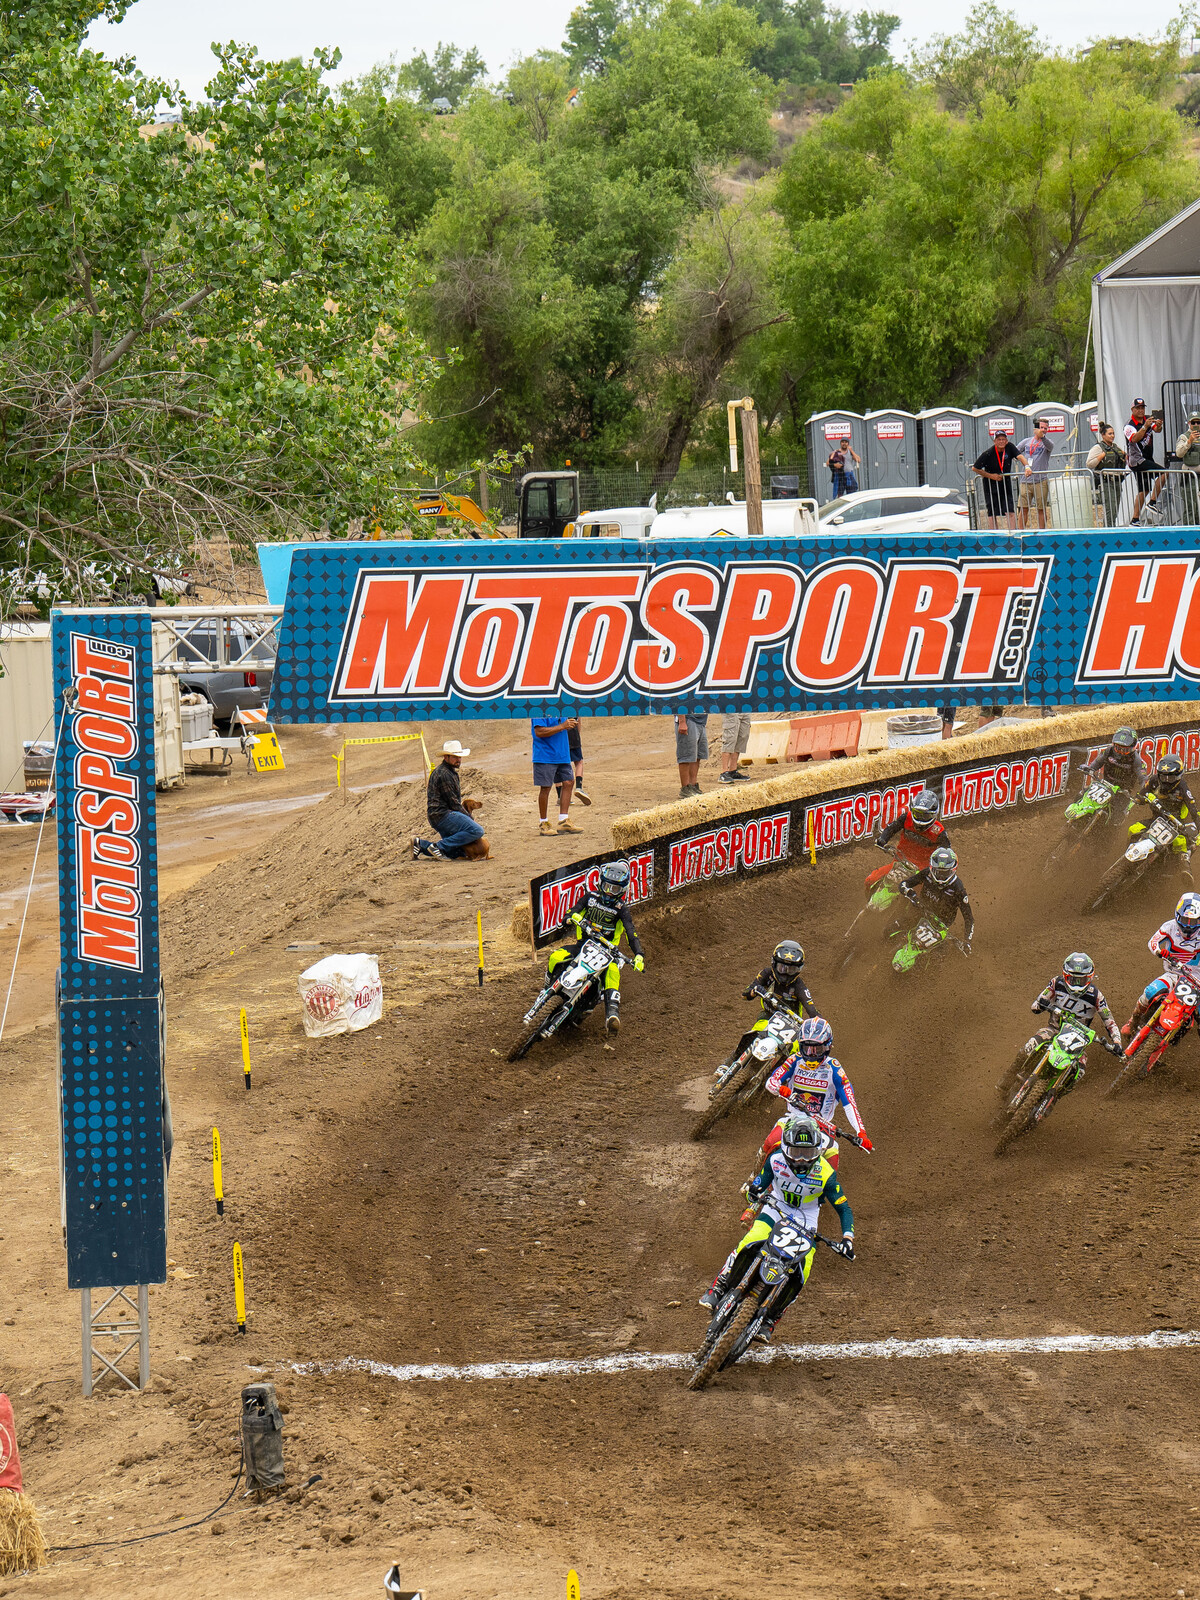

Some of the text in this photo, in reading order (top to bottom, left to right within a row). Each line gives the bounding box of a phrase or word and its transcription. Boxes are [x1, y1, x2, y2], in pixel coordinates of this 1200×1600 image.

[257, 755, 279, 768] EXIT
[1087, 783, 1112, 805] 243
[1149, 823, 1172, 845] 50
[583, 945, 610, 970] 38
[1055, 994, 1092, 1015] FOX
[1175, 984, 1198, 1006] 96
[767, 1018, 796, 1045] 24
[1057, 1031, 1087, 1051] 47
[794, 1075, 828, 1088] GASGAS
[773, 1227, 812, 1258] 32
